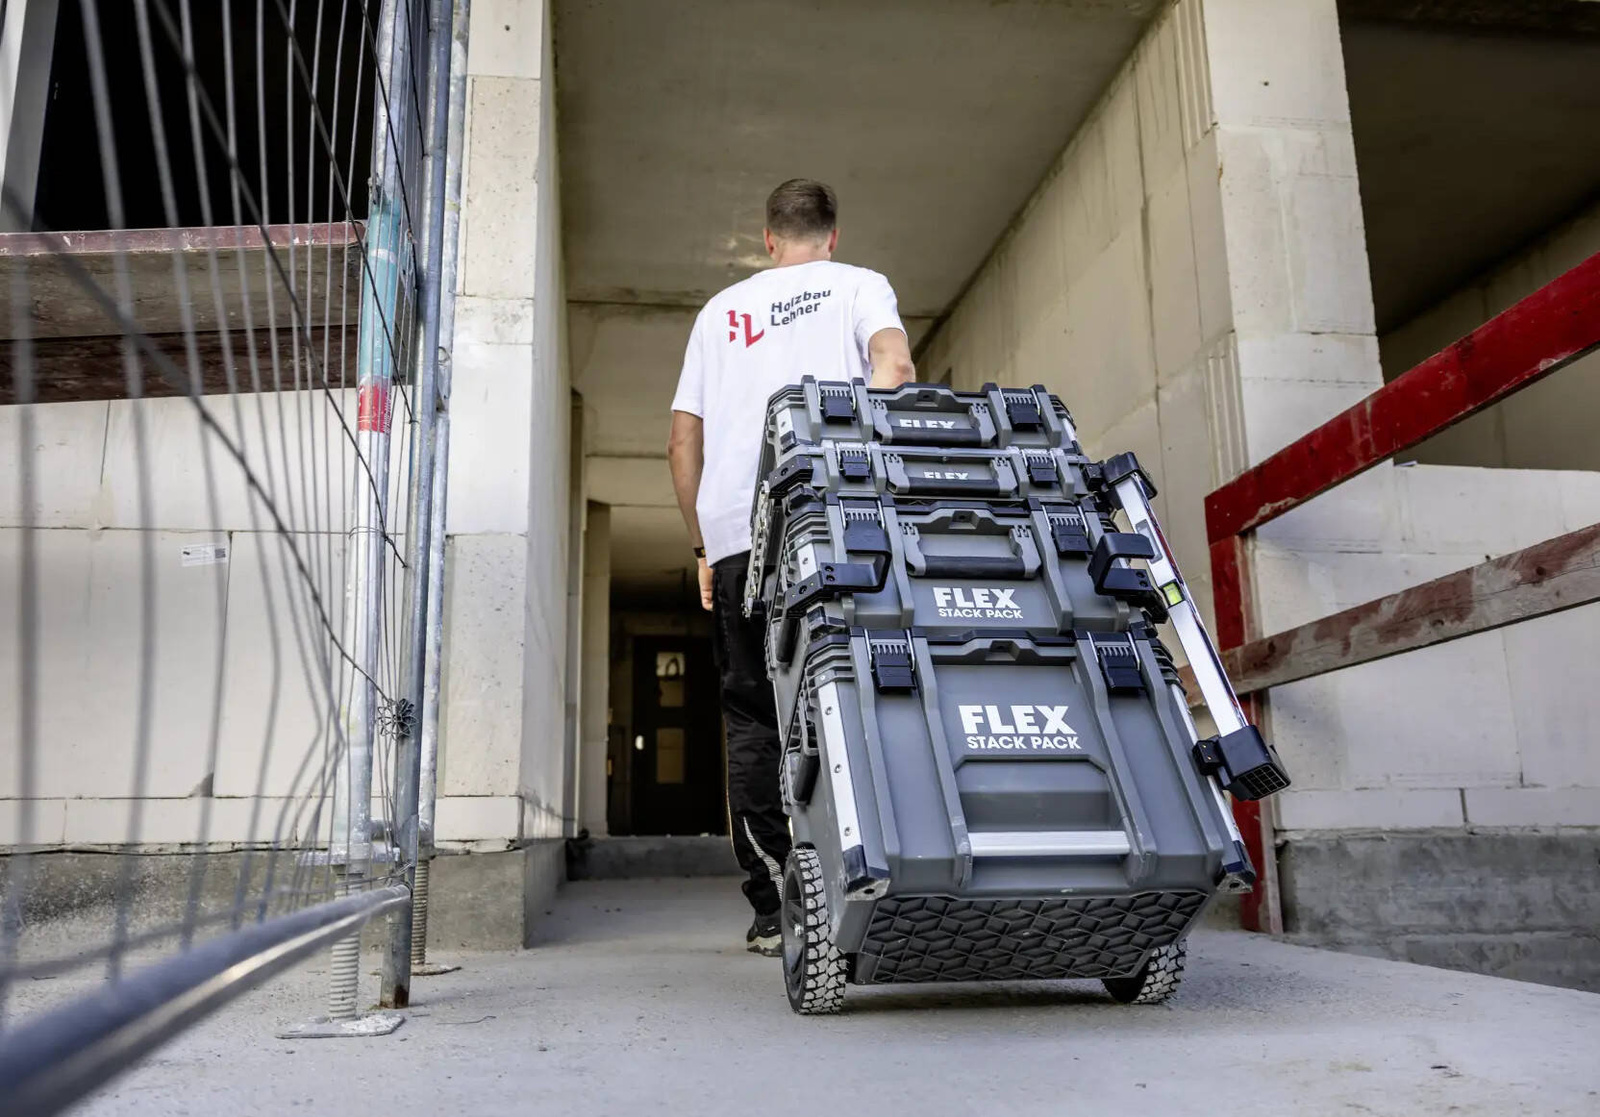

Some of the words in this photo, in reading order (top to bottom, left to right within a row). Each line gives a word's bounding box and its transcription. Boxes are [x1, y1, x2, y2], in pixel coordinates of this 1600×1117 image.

[771, 289, 831, 313] Holzbau
[932, 587, 1021, 609] FLEX
[938, 608, 983, 618] STACK
[985, 609, 1023, 619] PACK
[958, 705, 1077, 735] FLEX
[966, 736, 1027, 749] STACK
[1030, 736, 1082, 749] PACK
